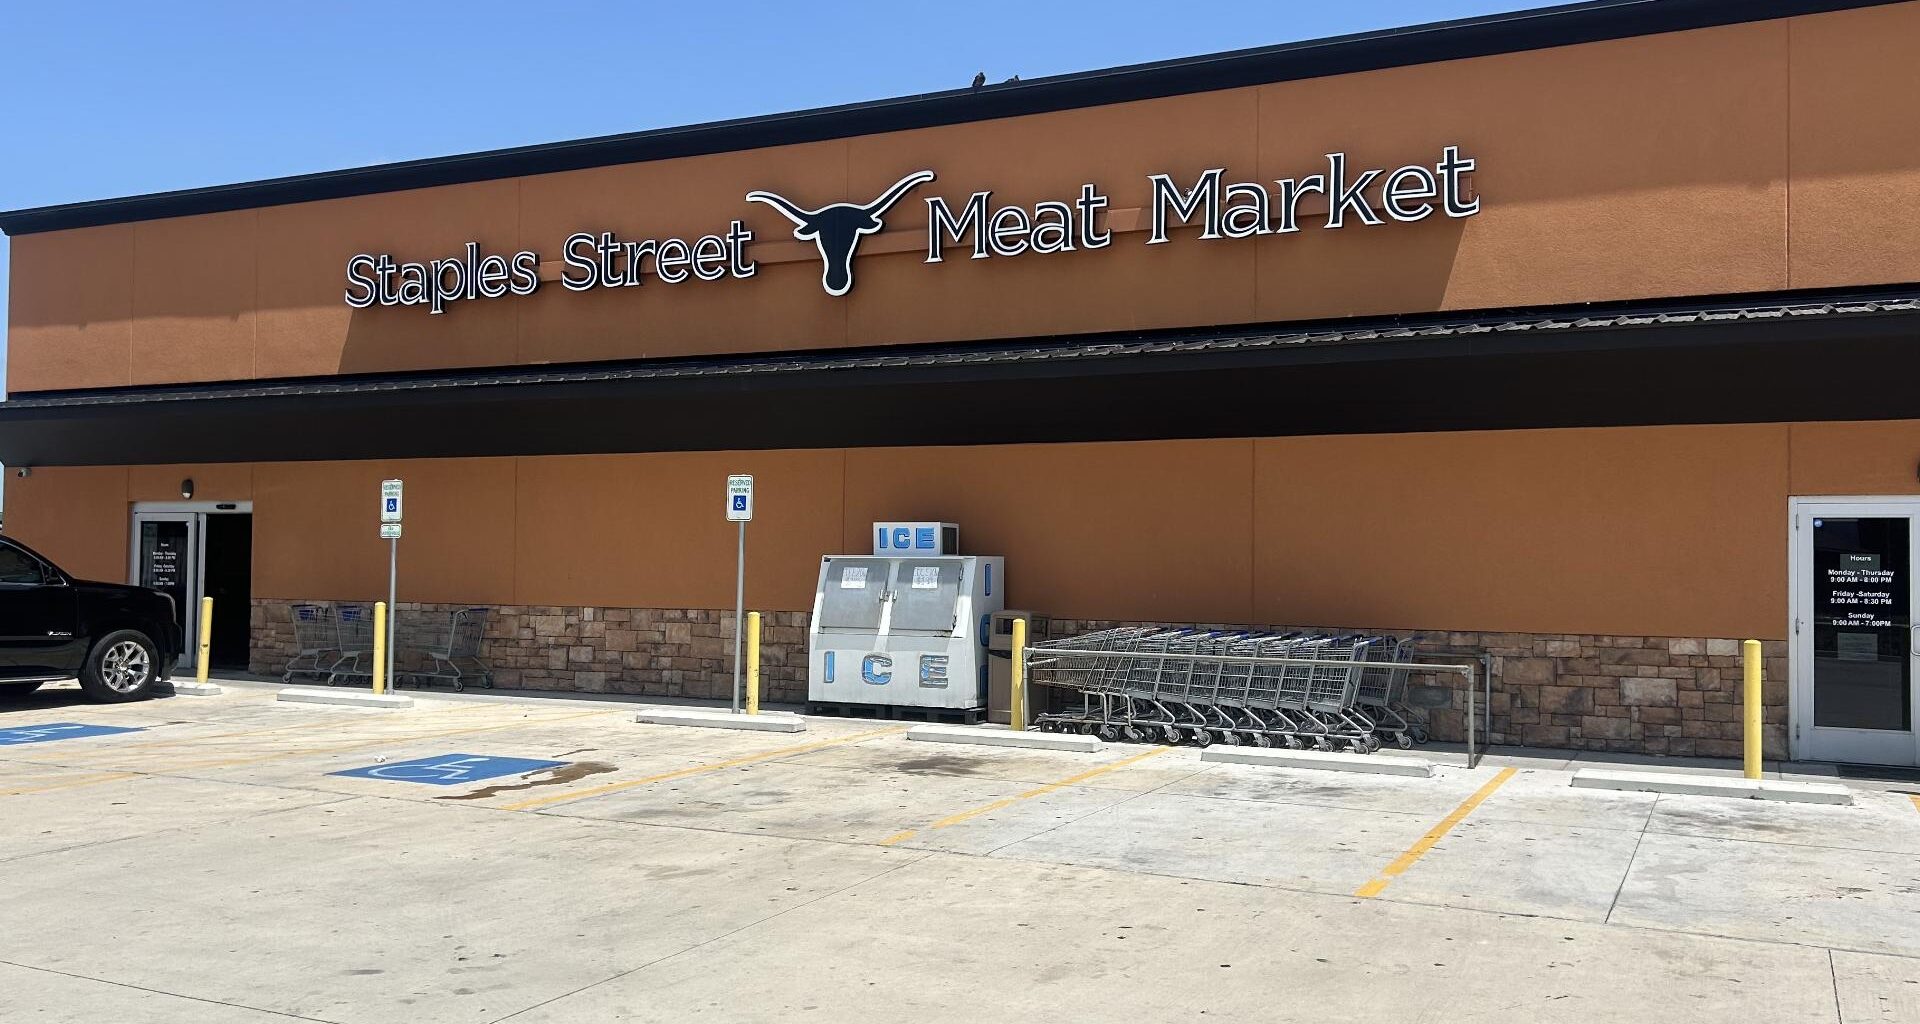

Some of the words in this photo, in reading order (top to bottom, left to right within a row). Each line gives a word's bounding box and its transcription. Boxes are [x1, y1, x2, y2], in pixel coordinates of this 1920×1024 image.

[344, 240, 540, 315] Staples
[561, 219, 759, 292] Street
[923, 183, 1112, 264] Meat
[1145, 145, 1481, 245] Market
[878, 527, 936, 549] ICE
[1828, 569, 1855, 577] Monday
[1861, 569, 1894, 577] Thursday
[1832, 590, 1855, 598] Friday
[1848, 612, 1875, 620] Sunday
[823, 650, 950, 689] ICE
